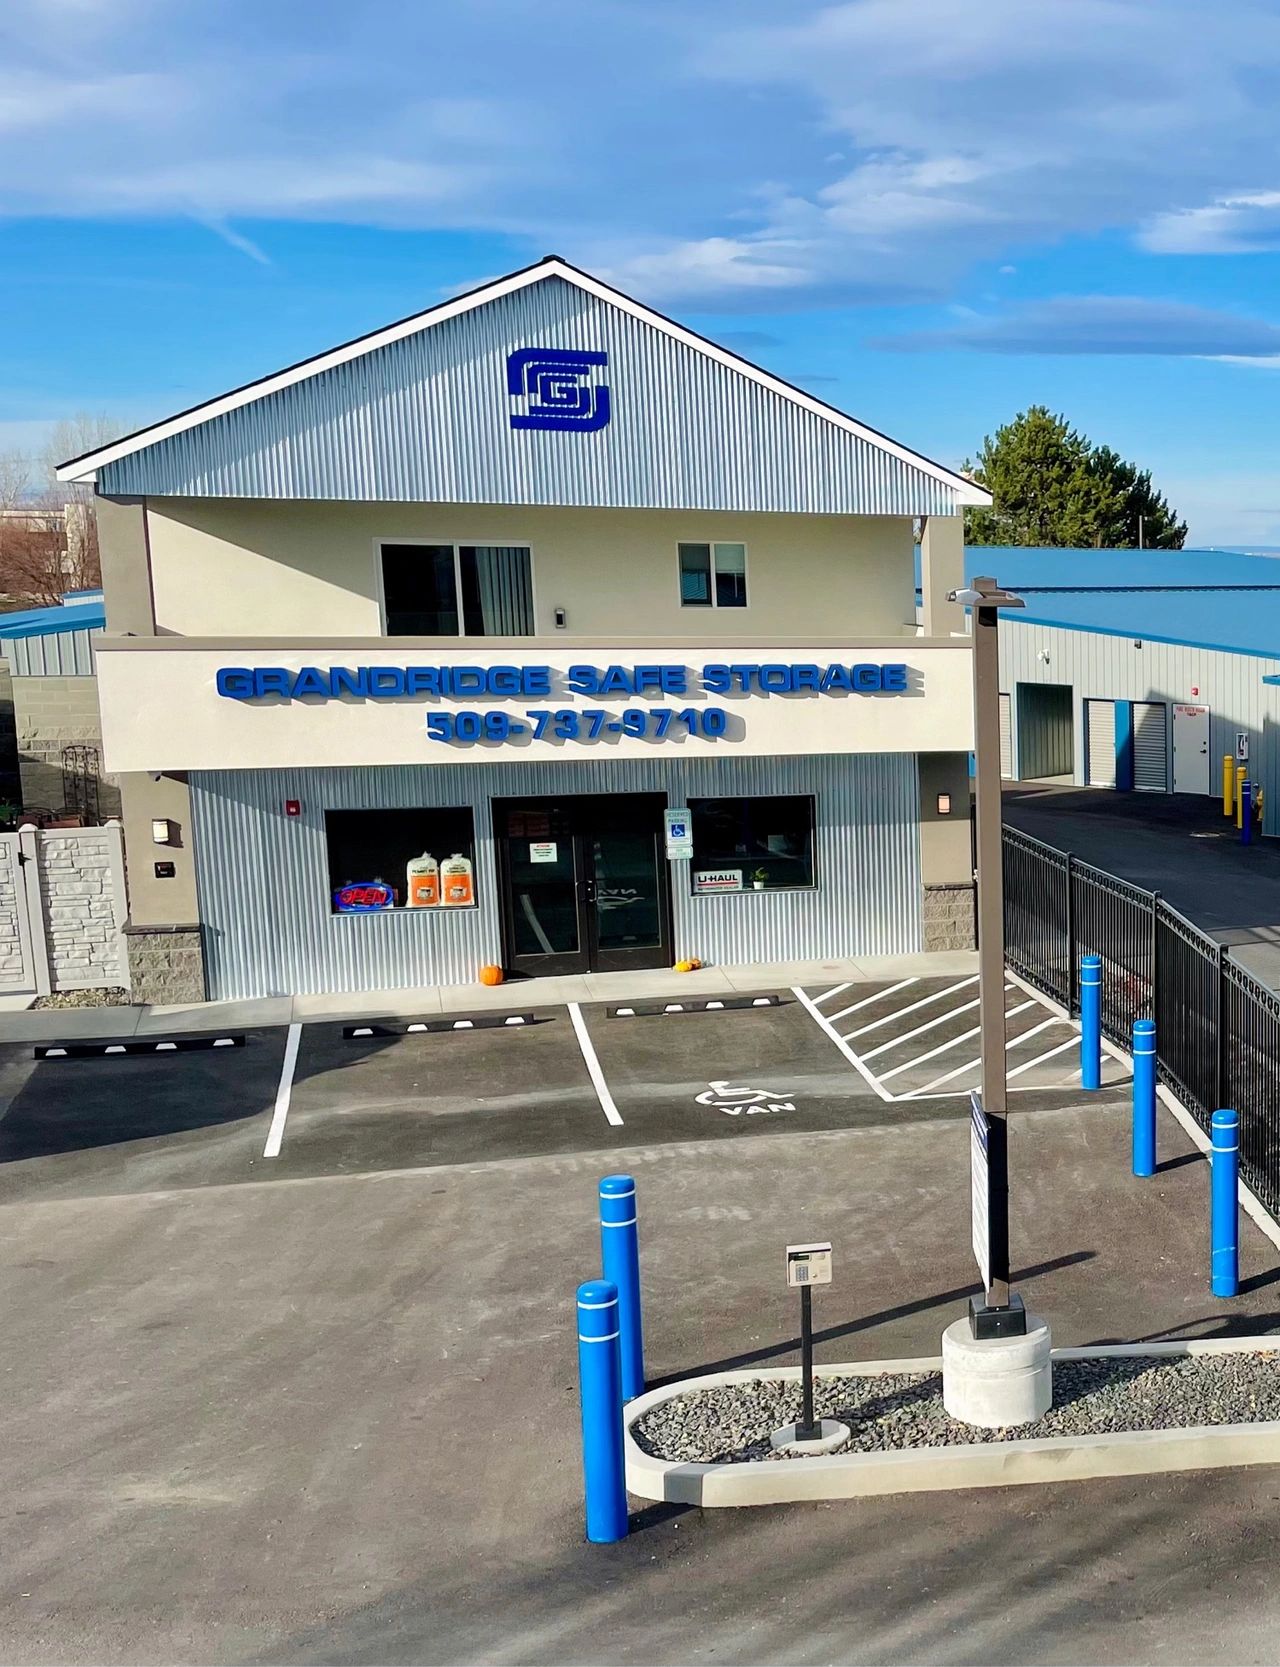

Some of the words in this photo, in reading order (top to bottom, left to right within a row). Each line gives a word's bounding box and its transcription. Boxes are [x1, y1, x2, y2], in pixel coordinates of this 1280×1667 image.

[215, 665, 551, 697] GRANDRIDGE
[568, 664, 687, 694] SAFE
[702, 663, 907, 693] STORAGE
[426, 707, 726, 741] 509-737-9710
[340, 888, 387, 904] OPEN
[719, 1102, 797, 1115] VAN
